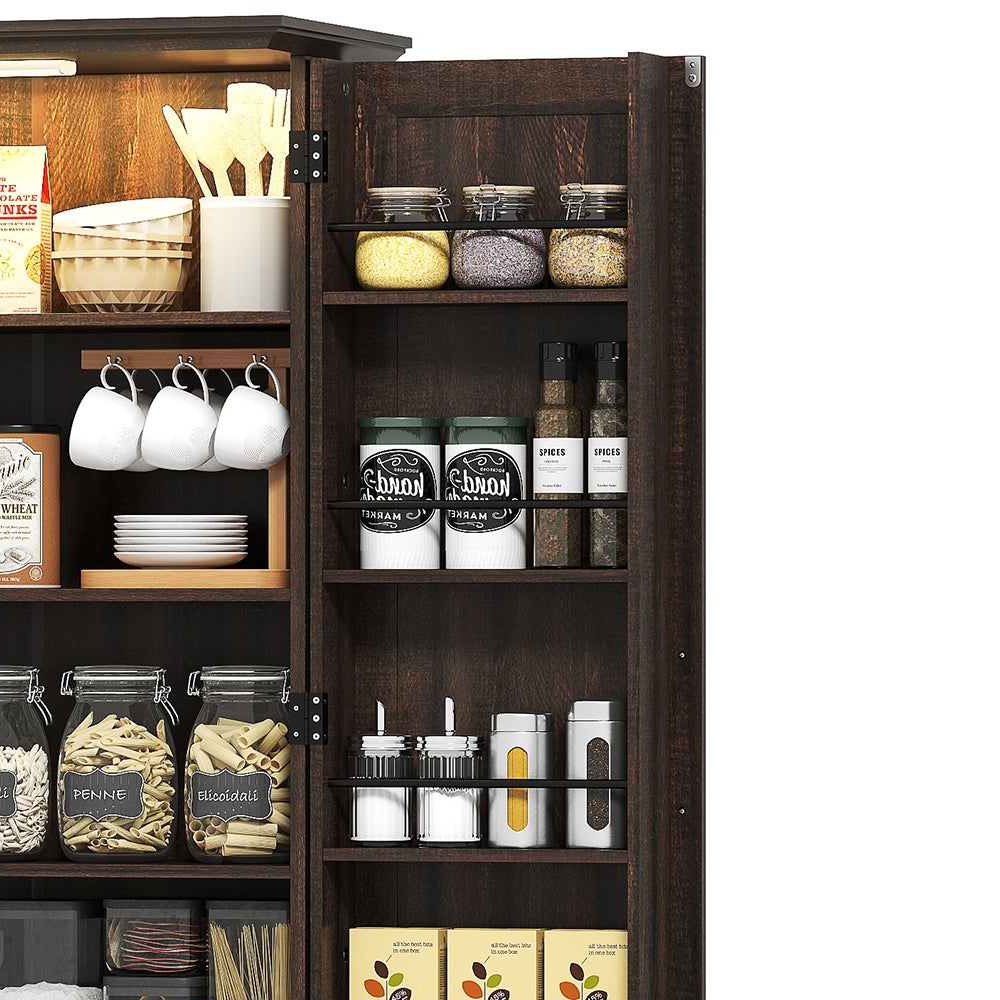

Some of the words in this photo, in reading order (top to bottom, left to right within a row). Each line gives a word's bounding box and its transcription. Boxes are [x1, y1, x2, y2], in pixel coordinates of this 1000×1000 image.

[594, 448, 620, 456] SPICES
[1, 504, 38, 514] WHEAT
[73, 789, 127, 800] PENNE
[198, 789, 258, 801] Elicoidali
